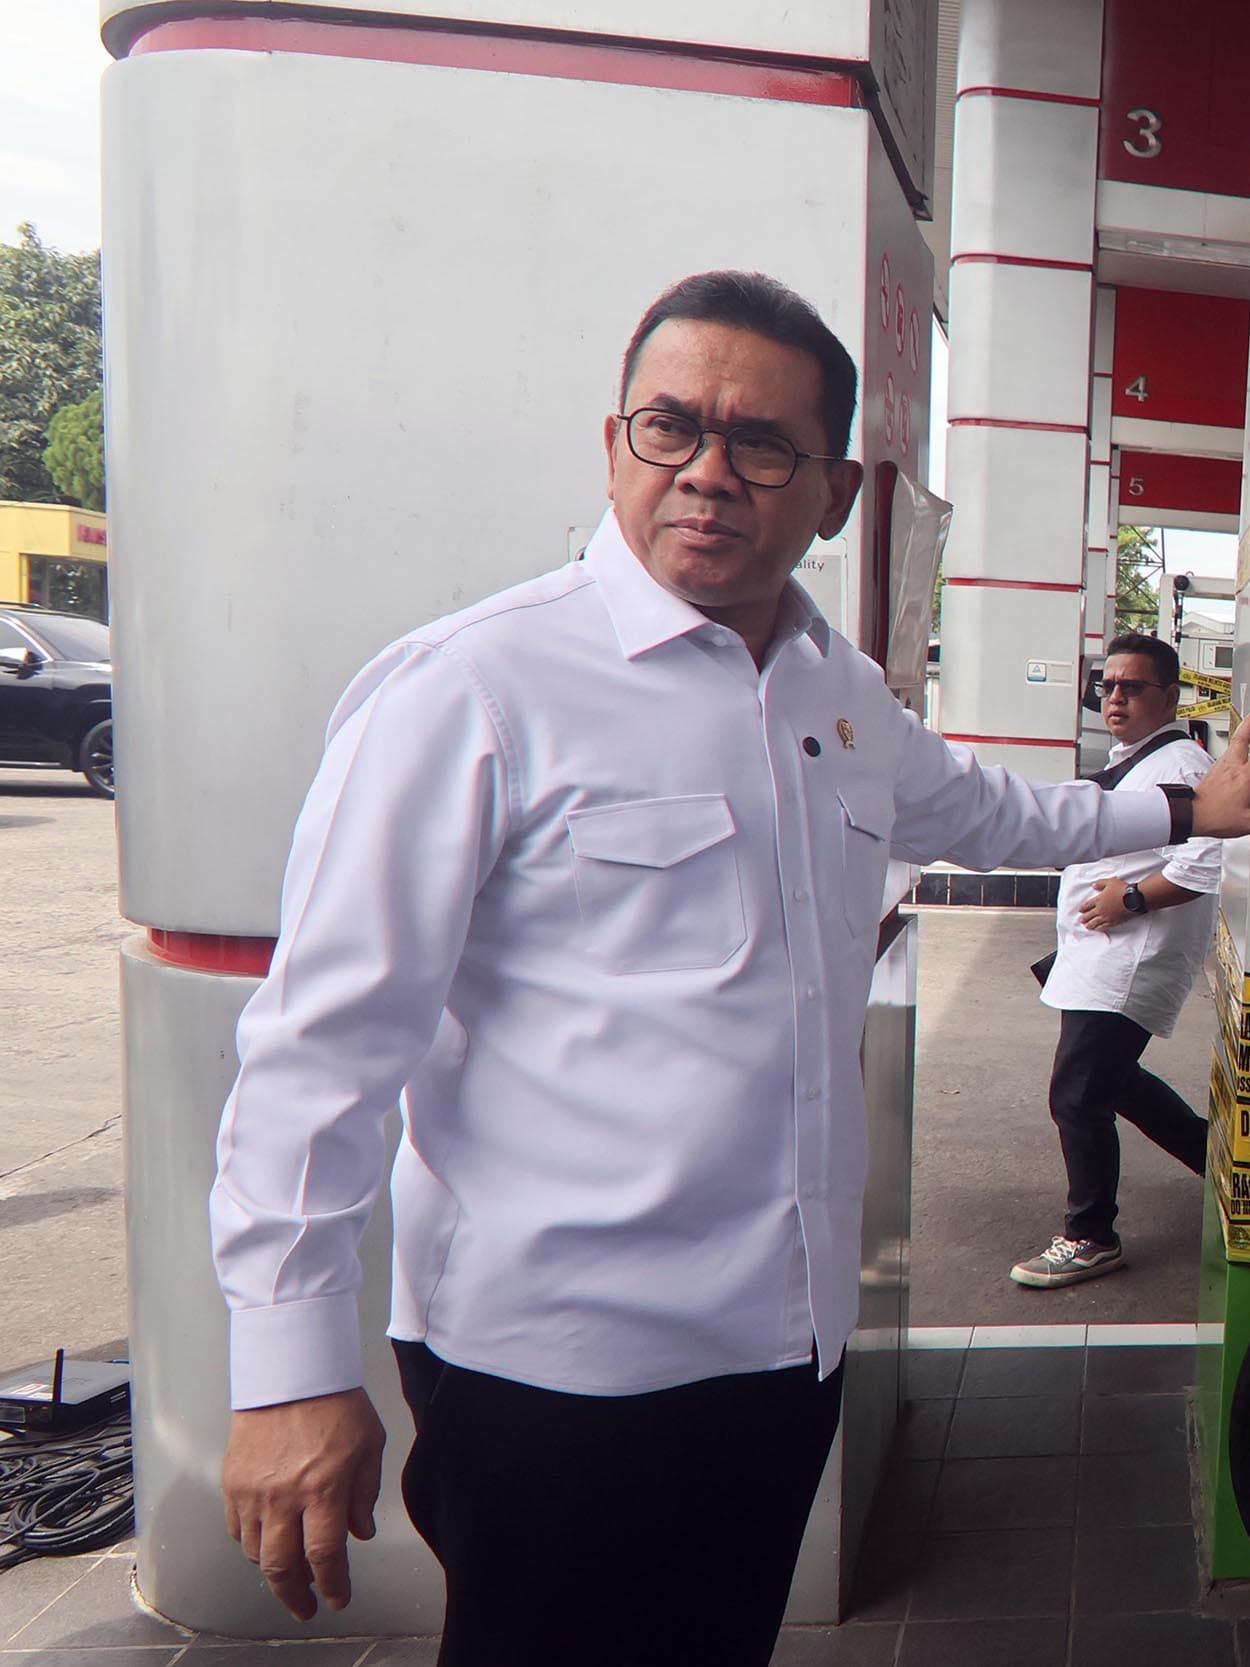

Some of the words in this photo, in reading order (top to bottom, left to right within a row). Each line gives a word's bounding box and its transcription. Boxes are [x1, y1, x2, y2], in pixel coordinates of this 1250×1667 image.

[1122, 107, 1163, 158] 3
[1125, 373, 1148, 402] 4
[1128, 477, 1145, 496] 5
